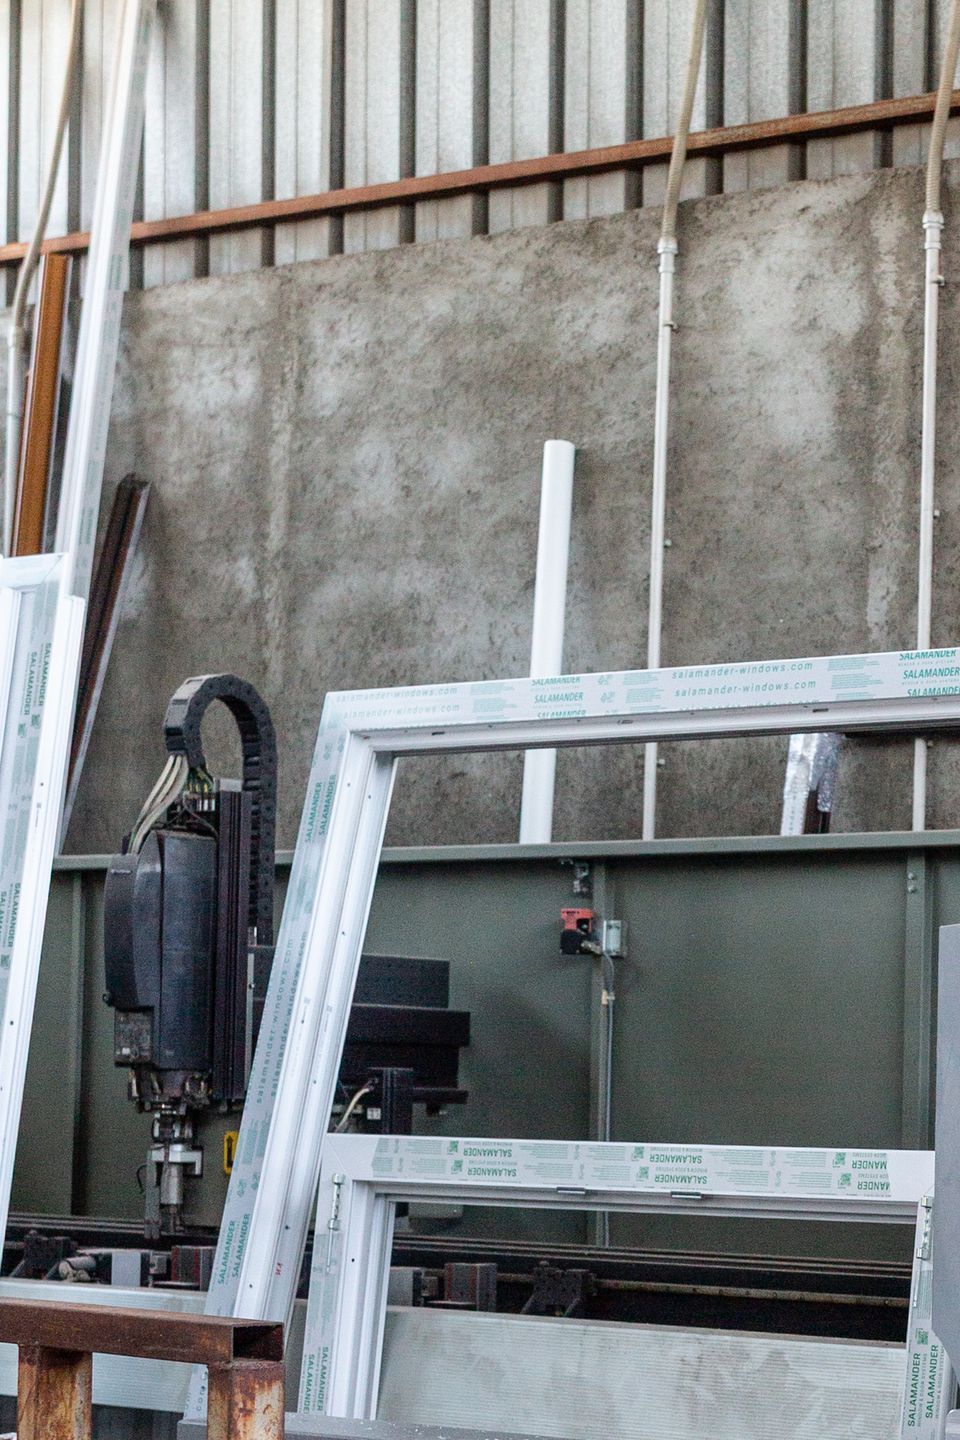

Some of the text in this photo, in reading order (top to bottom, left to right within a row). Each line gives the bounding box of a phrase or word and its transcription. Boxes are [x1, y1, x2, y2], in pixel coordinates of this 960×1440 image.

[672, 662, 813, 679] salamander-windows.com
[903, 667, 960, 680] SALAMANDER
[534, 691, 584, 703] SALAMANDER
[675, 680, 816, 697] salamander-windows.com
[306, 782, 322, 842] SALAMANDER
[463, 1148, 512, 1158] SALAMANDER
[649, 1154, 703, 1164] SALAMANDER
[467, 1167, 517, 1177] SALAMANDER
[654, 1174, 708, 1185] SALAMANDER
[218, 1220, 236, 1285] SALAMANDER
[232, 1213, 250, 1278] SALAMANDER
[317, 1346, 328, 1412] SALAMANDER
[925, 1344, 938, 1419] SALAMANDER
[908, 1352, 921, 1427] SALAMANDER
